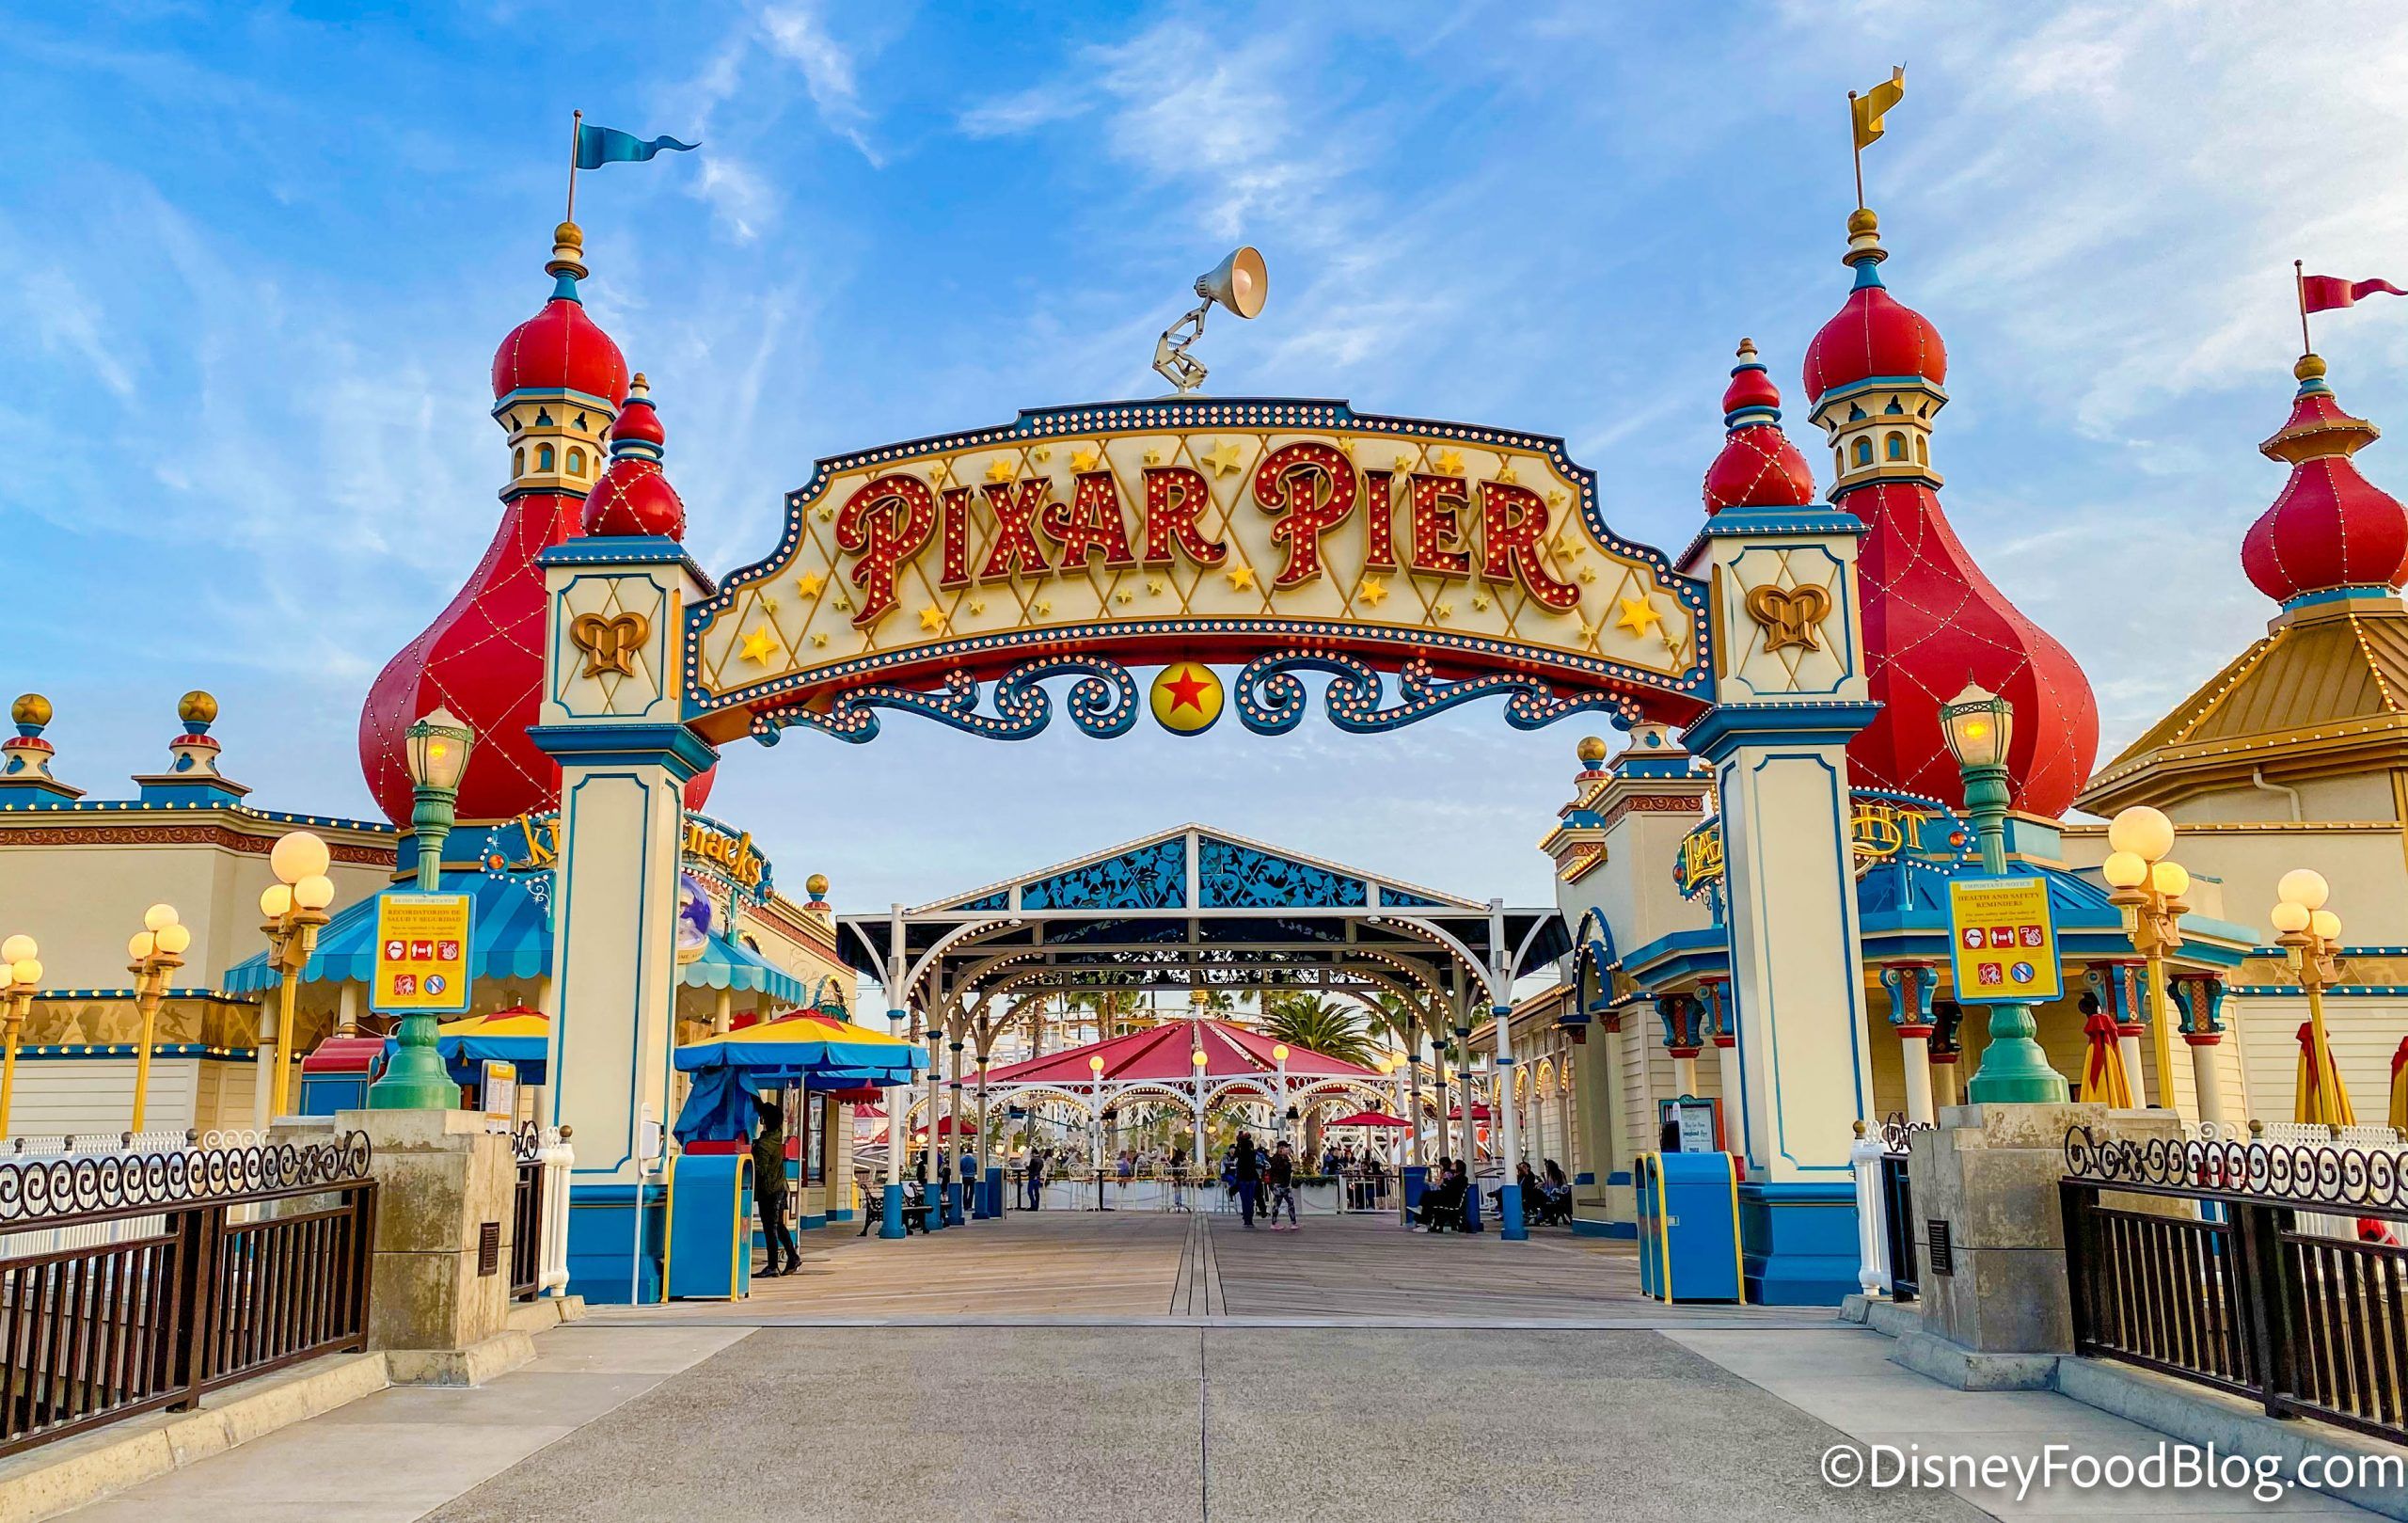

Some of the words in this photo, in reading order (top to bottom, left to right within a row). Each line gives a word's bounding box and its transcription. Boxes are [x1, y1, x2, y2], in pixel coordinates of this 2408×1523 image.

[834, 465, 1229, 630] PIXAR
[1252, 440, 1582, 615] PIER
[681, 816, 763, 886] nacks
